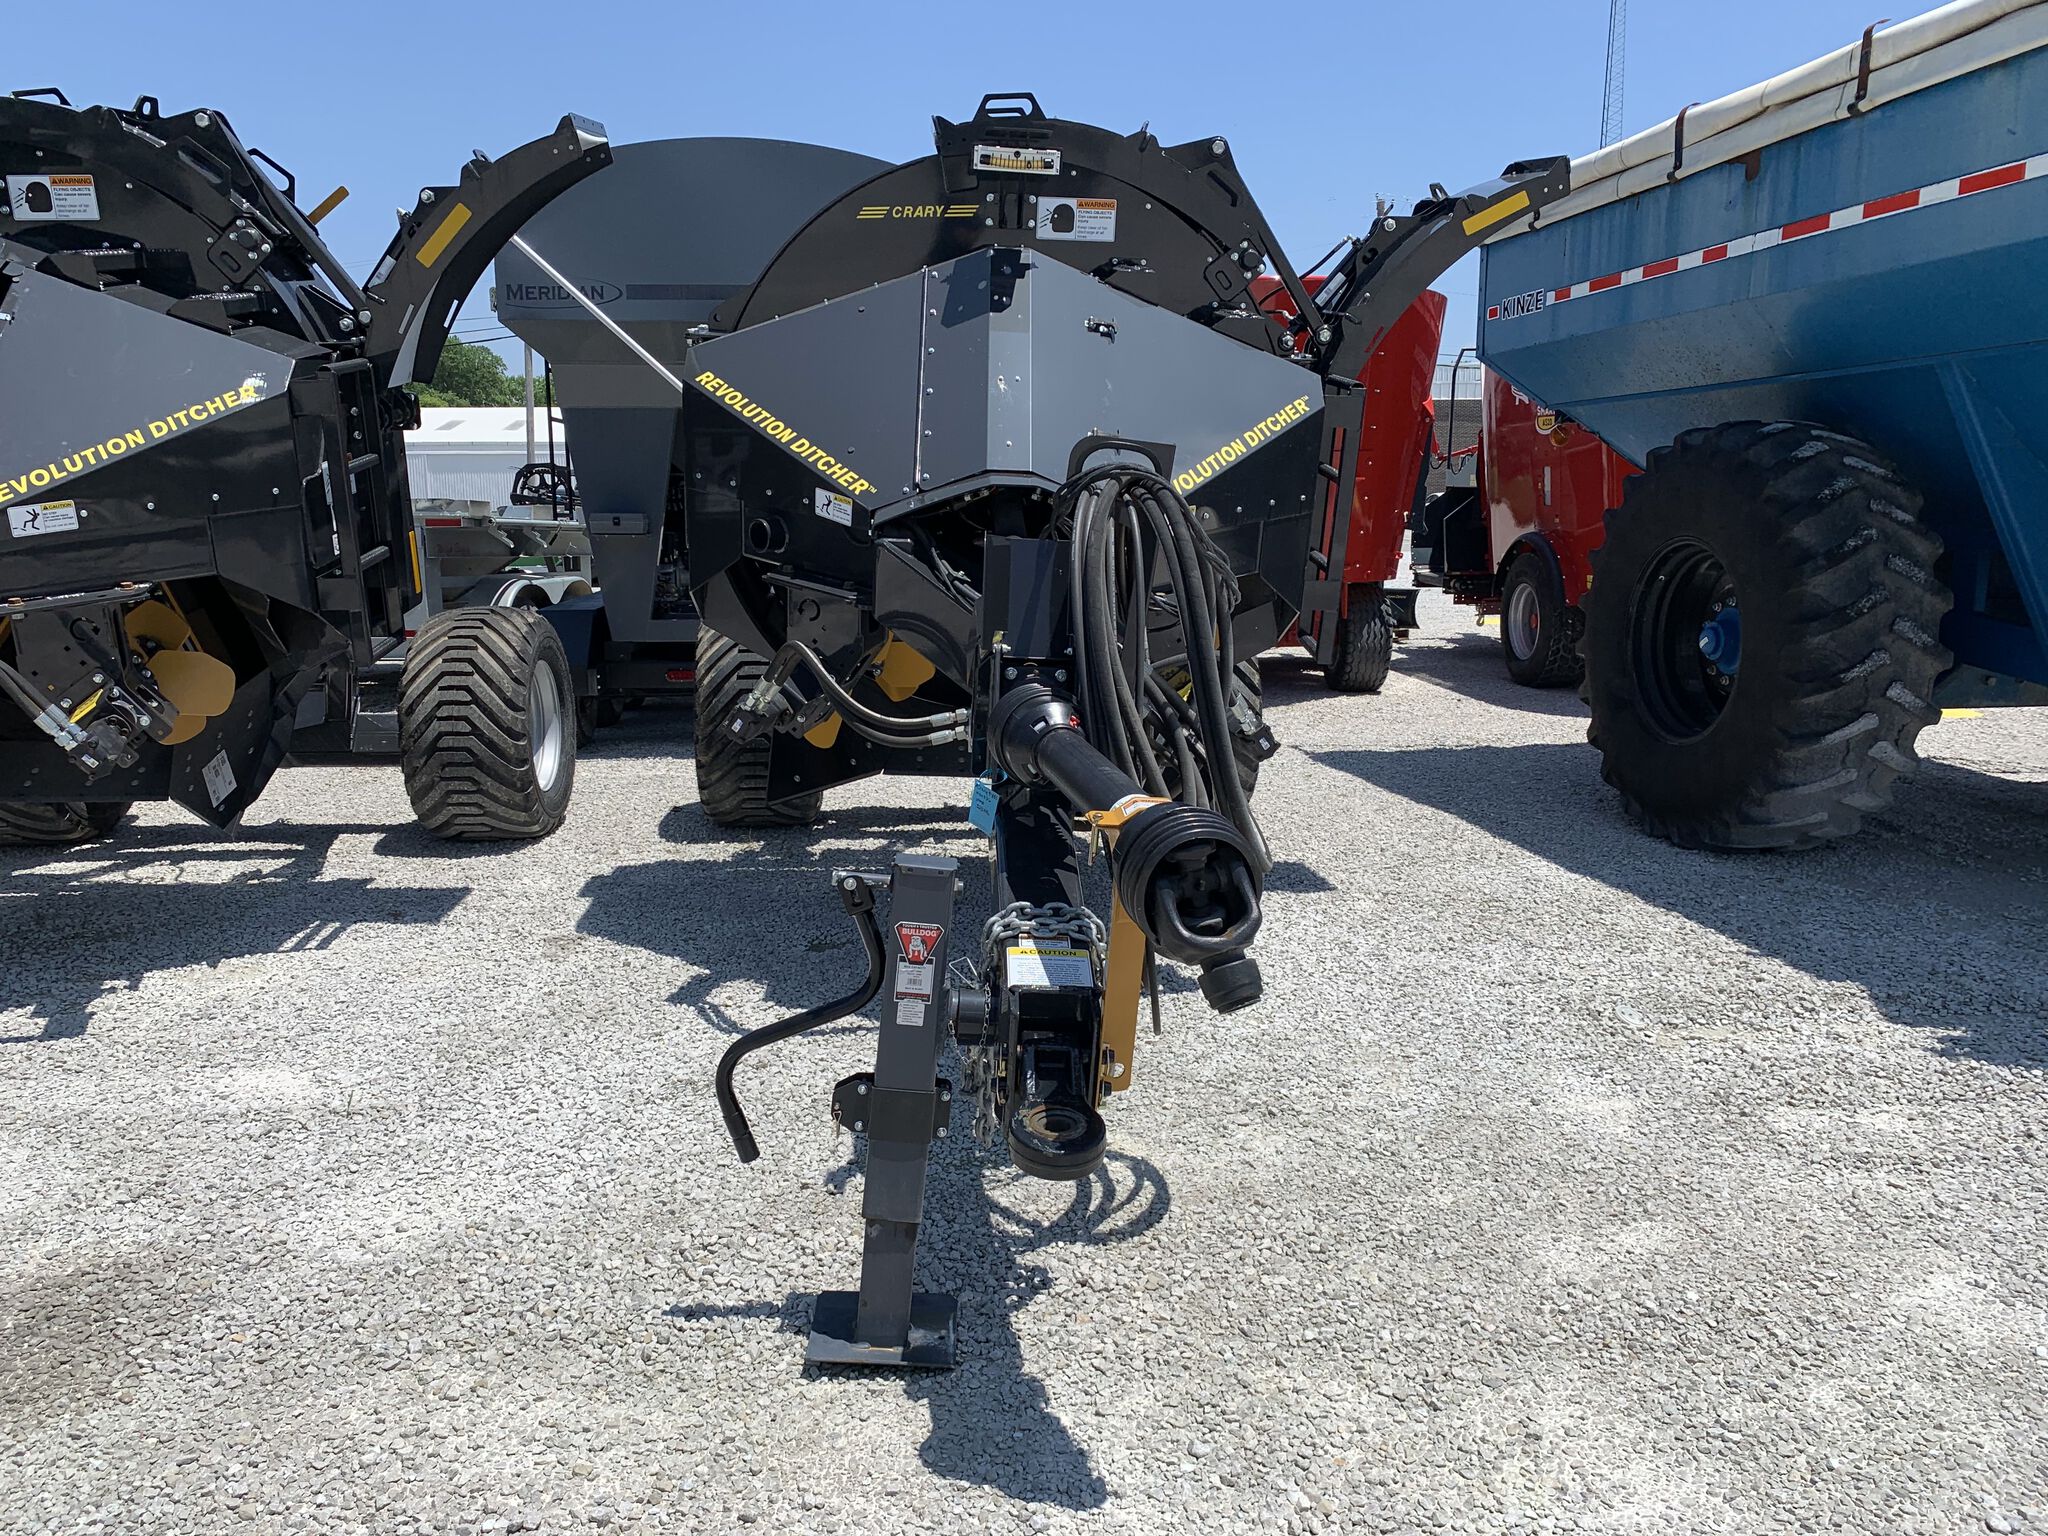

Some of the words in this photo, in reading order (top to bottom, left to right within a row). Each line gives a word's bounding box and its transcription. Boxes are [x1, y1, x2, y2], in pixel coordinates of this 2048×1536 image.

[892, 205, 944, 218] CRARY
[506, 283, 604, 300] MERIDAN
[1502, 288, 1544, 320] KINZE
[149, 385, 258, 439] DITCHER
[695, 371, 798, 443] REVOLUTION
